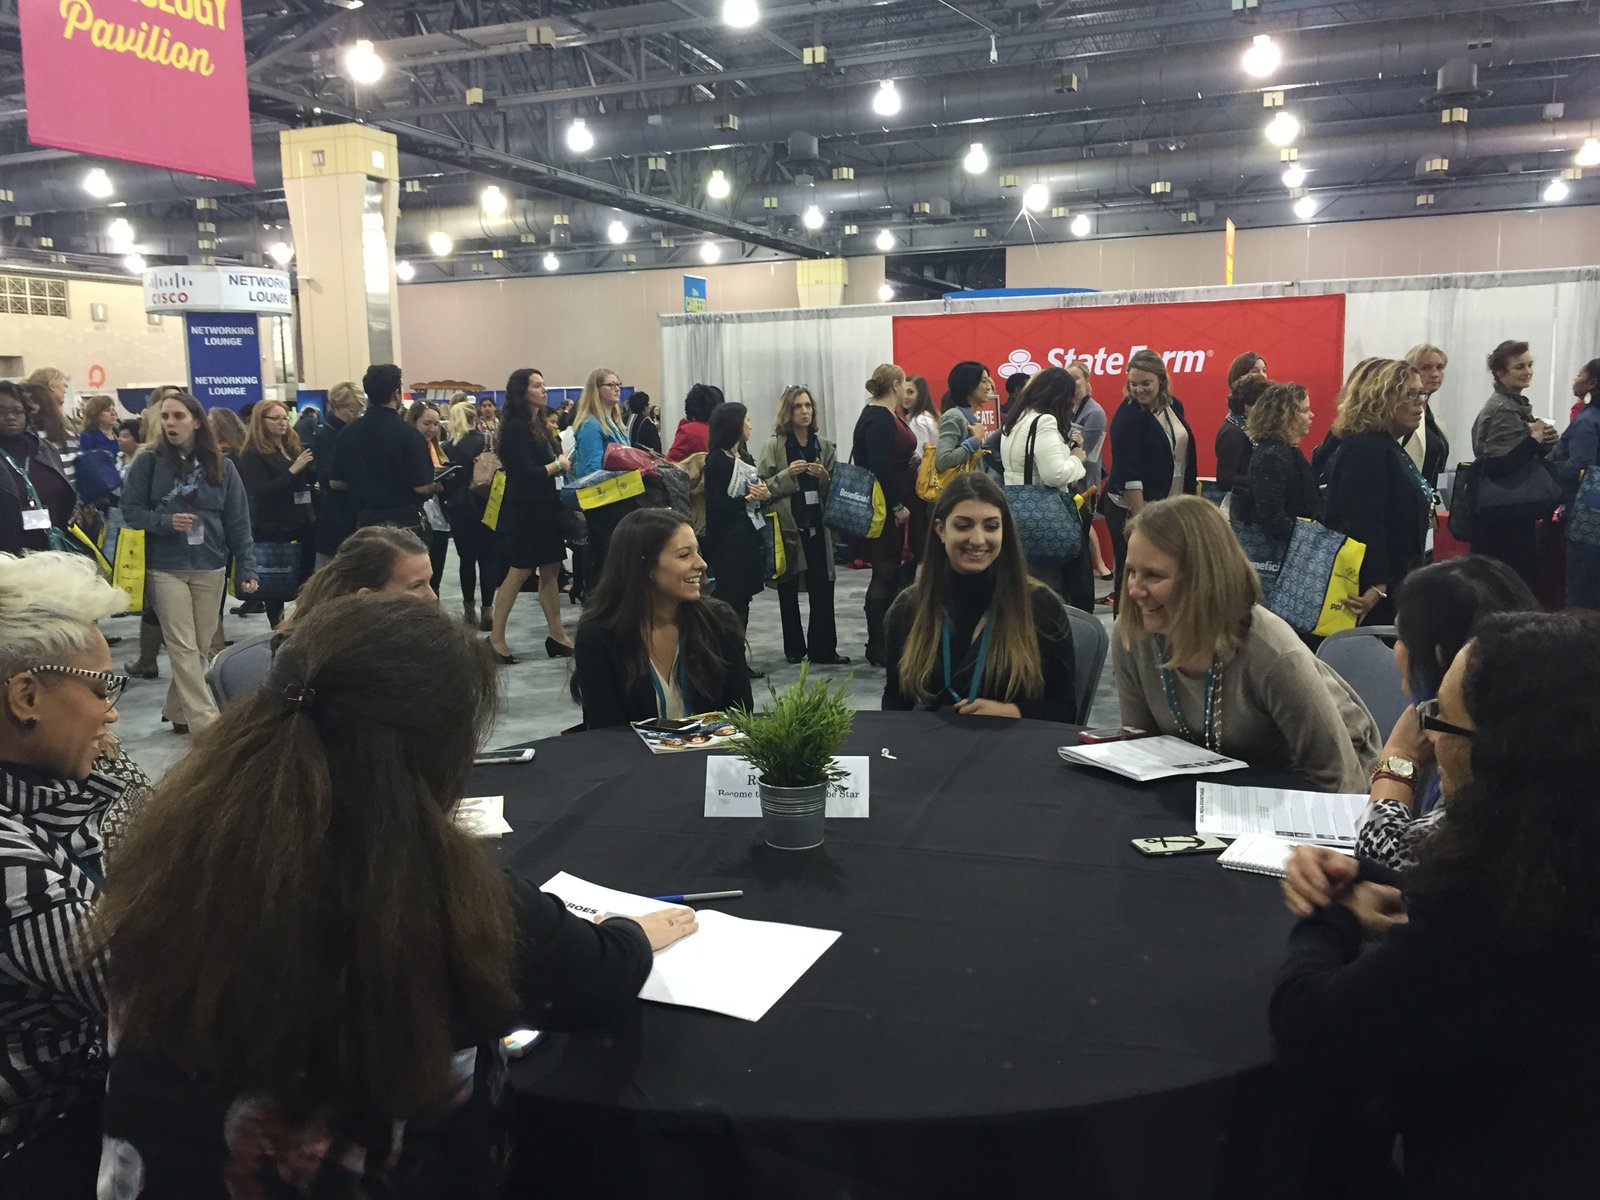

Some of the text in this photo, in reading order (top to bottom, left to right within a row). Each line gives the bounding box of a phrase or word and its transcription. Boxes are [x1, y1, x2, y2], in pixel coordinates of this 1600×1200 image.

[59, 0, 215, 77] Pavilion
[152, 292, 189, 304] CISCO
[248, 290, 288, 304] LOUNGE
[191, 326, 254, 335] NETWORKING
[204, 337, 243, 346] LOUNGE
[1126, 345, 1206, 374] Frm
[195, 376, 258, 385] NETWORKING
[208, 387, 247, 396] LOUNGE
[974, 410, 995, 425] EATE
[1252, 561, 1280, 572] nefici
